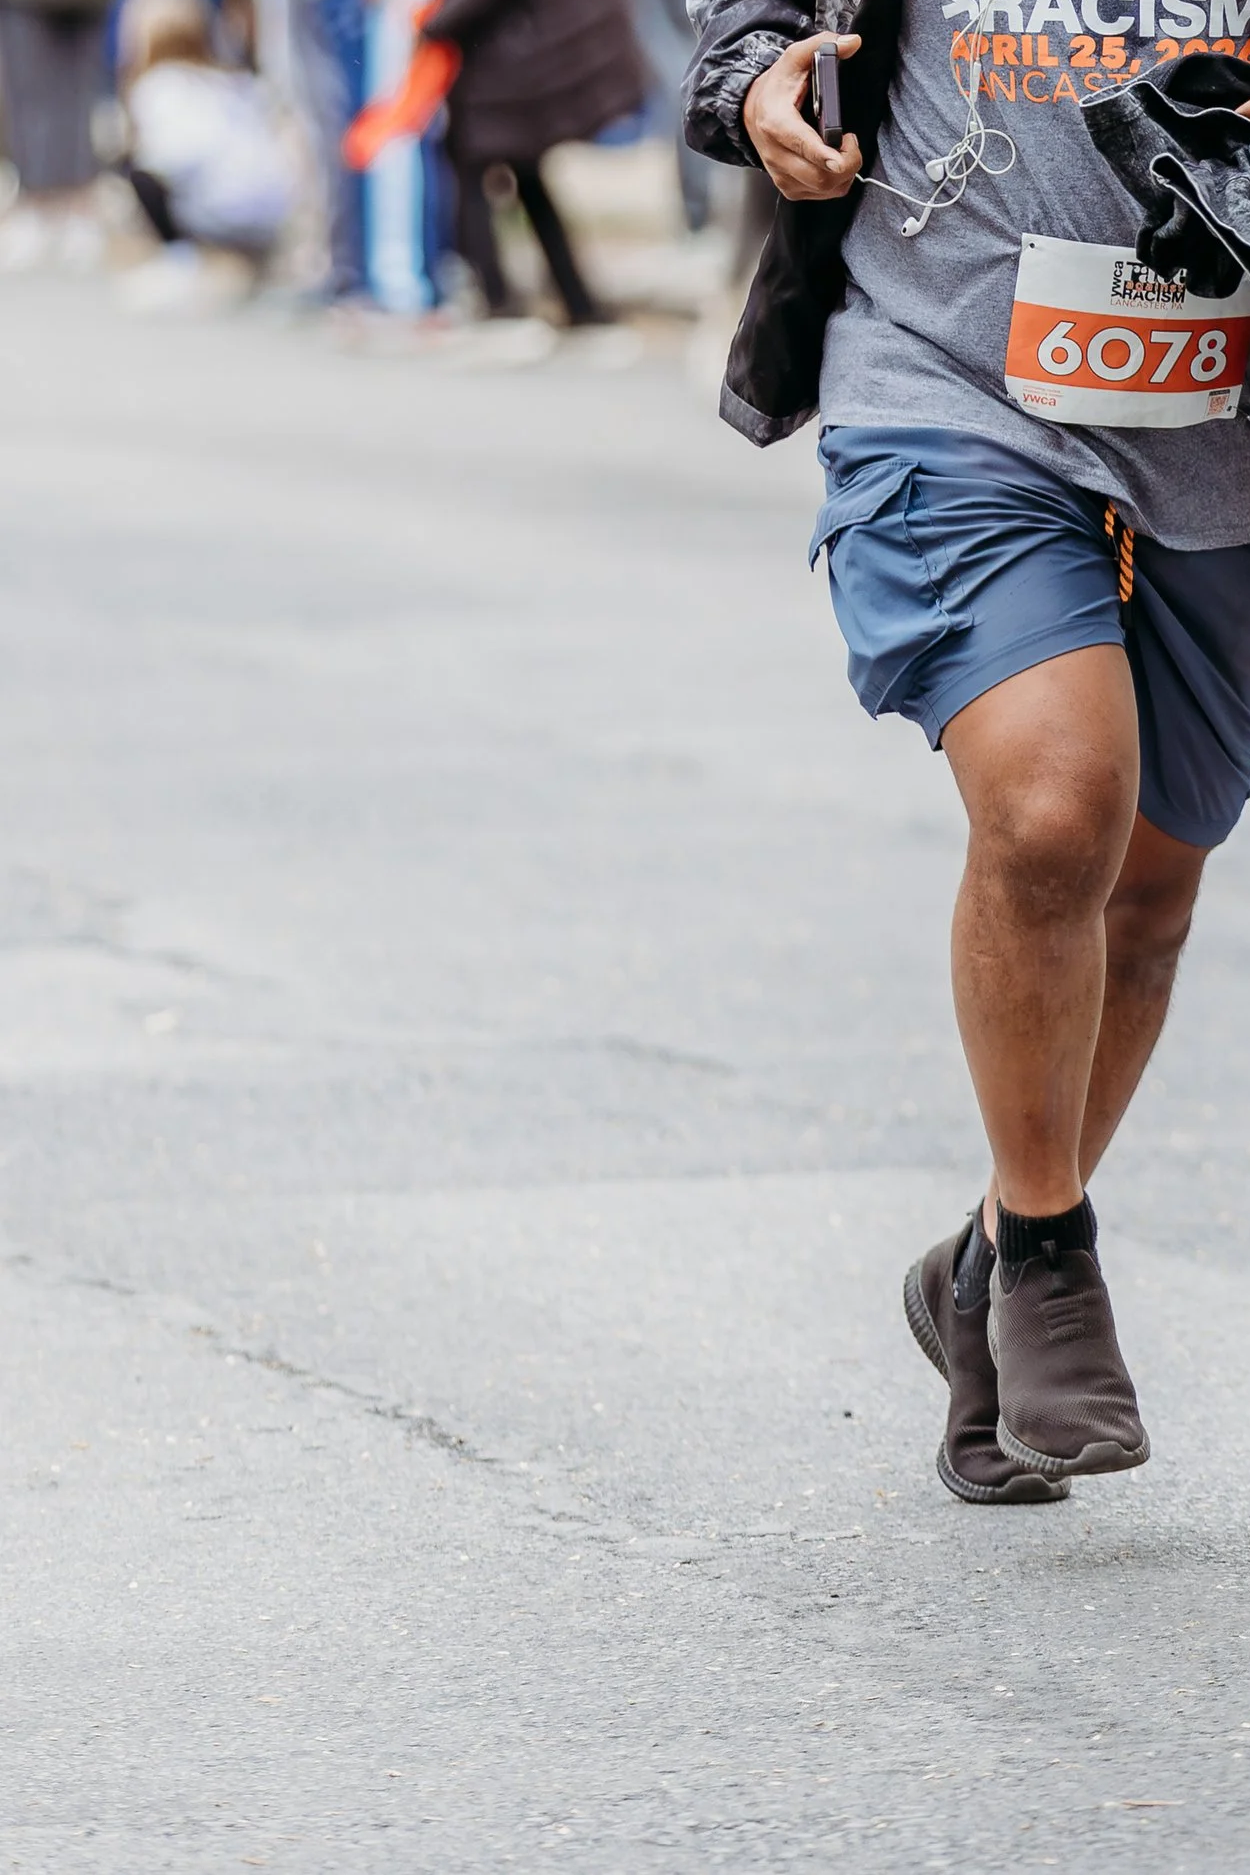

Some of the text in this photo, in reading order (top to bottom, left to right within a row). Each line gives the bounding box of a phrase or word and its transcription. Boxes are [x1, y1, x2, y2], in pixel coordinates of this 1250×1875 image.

[951, 30, 1060, 67] APRIL
[1069, 35, 1142, 74] 25,
[1111, 261, 1124, 298] ywca
[1110, 298, 1184, 311] LANCASTER, PA
[1122, 287, 1187, 303] RACISM
[1037, 321, 1228, 384] 6078
[1022, 392, 1057, 407] ywca
